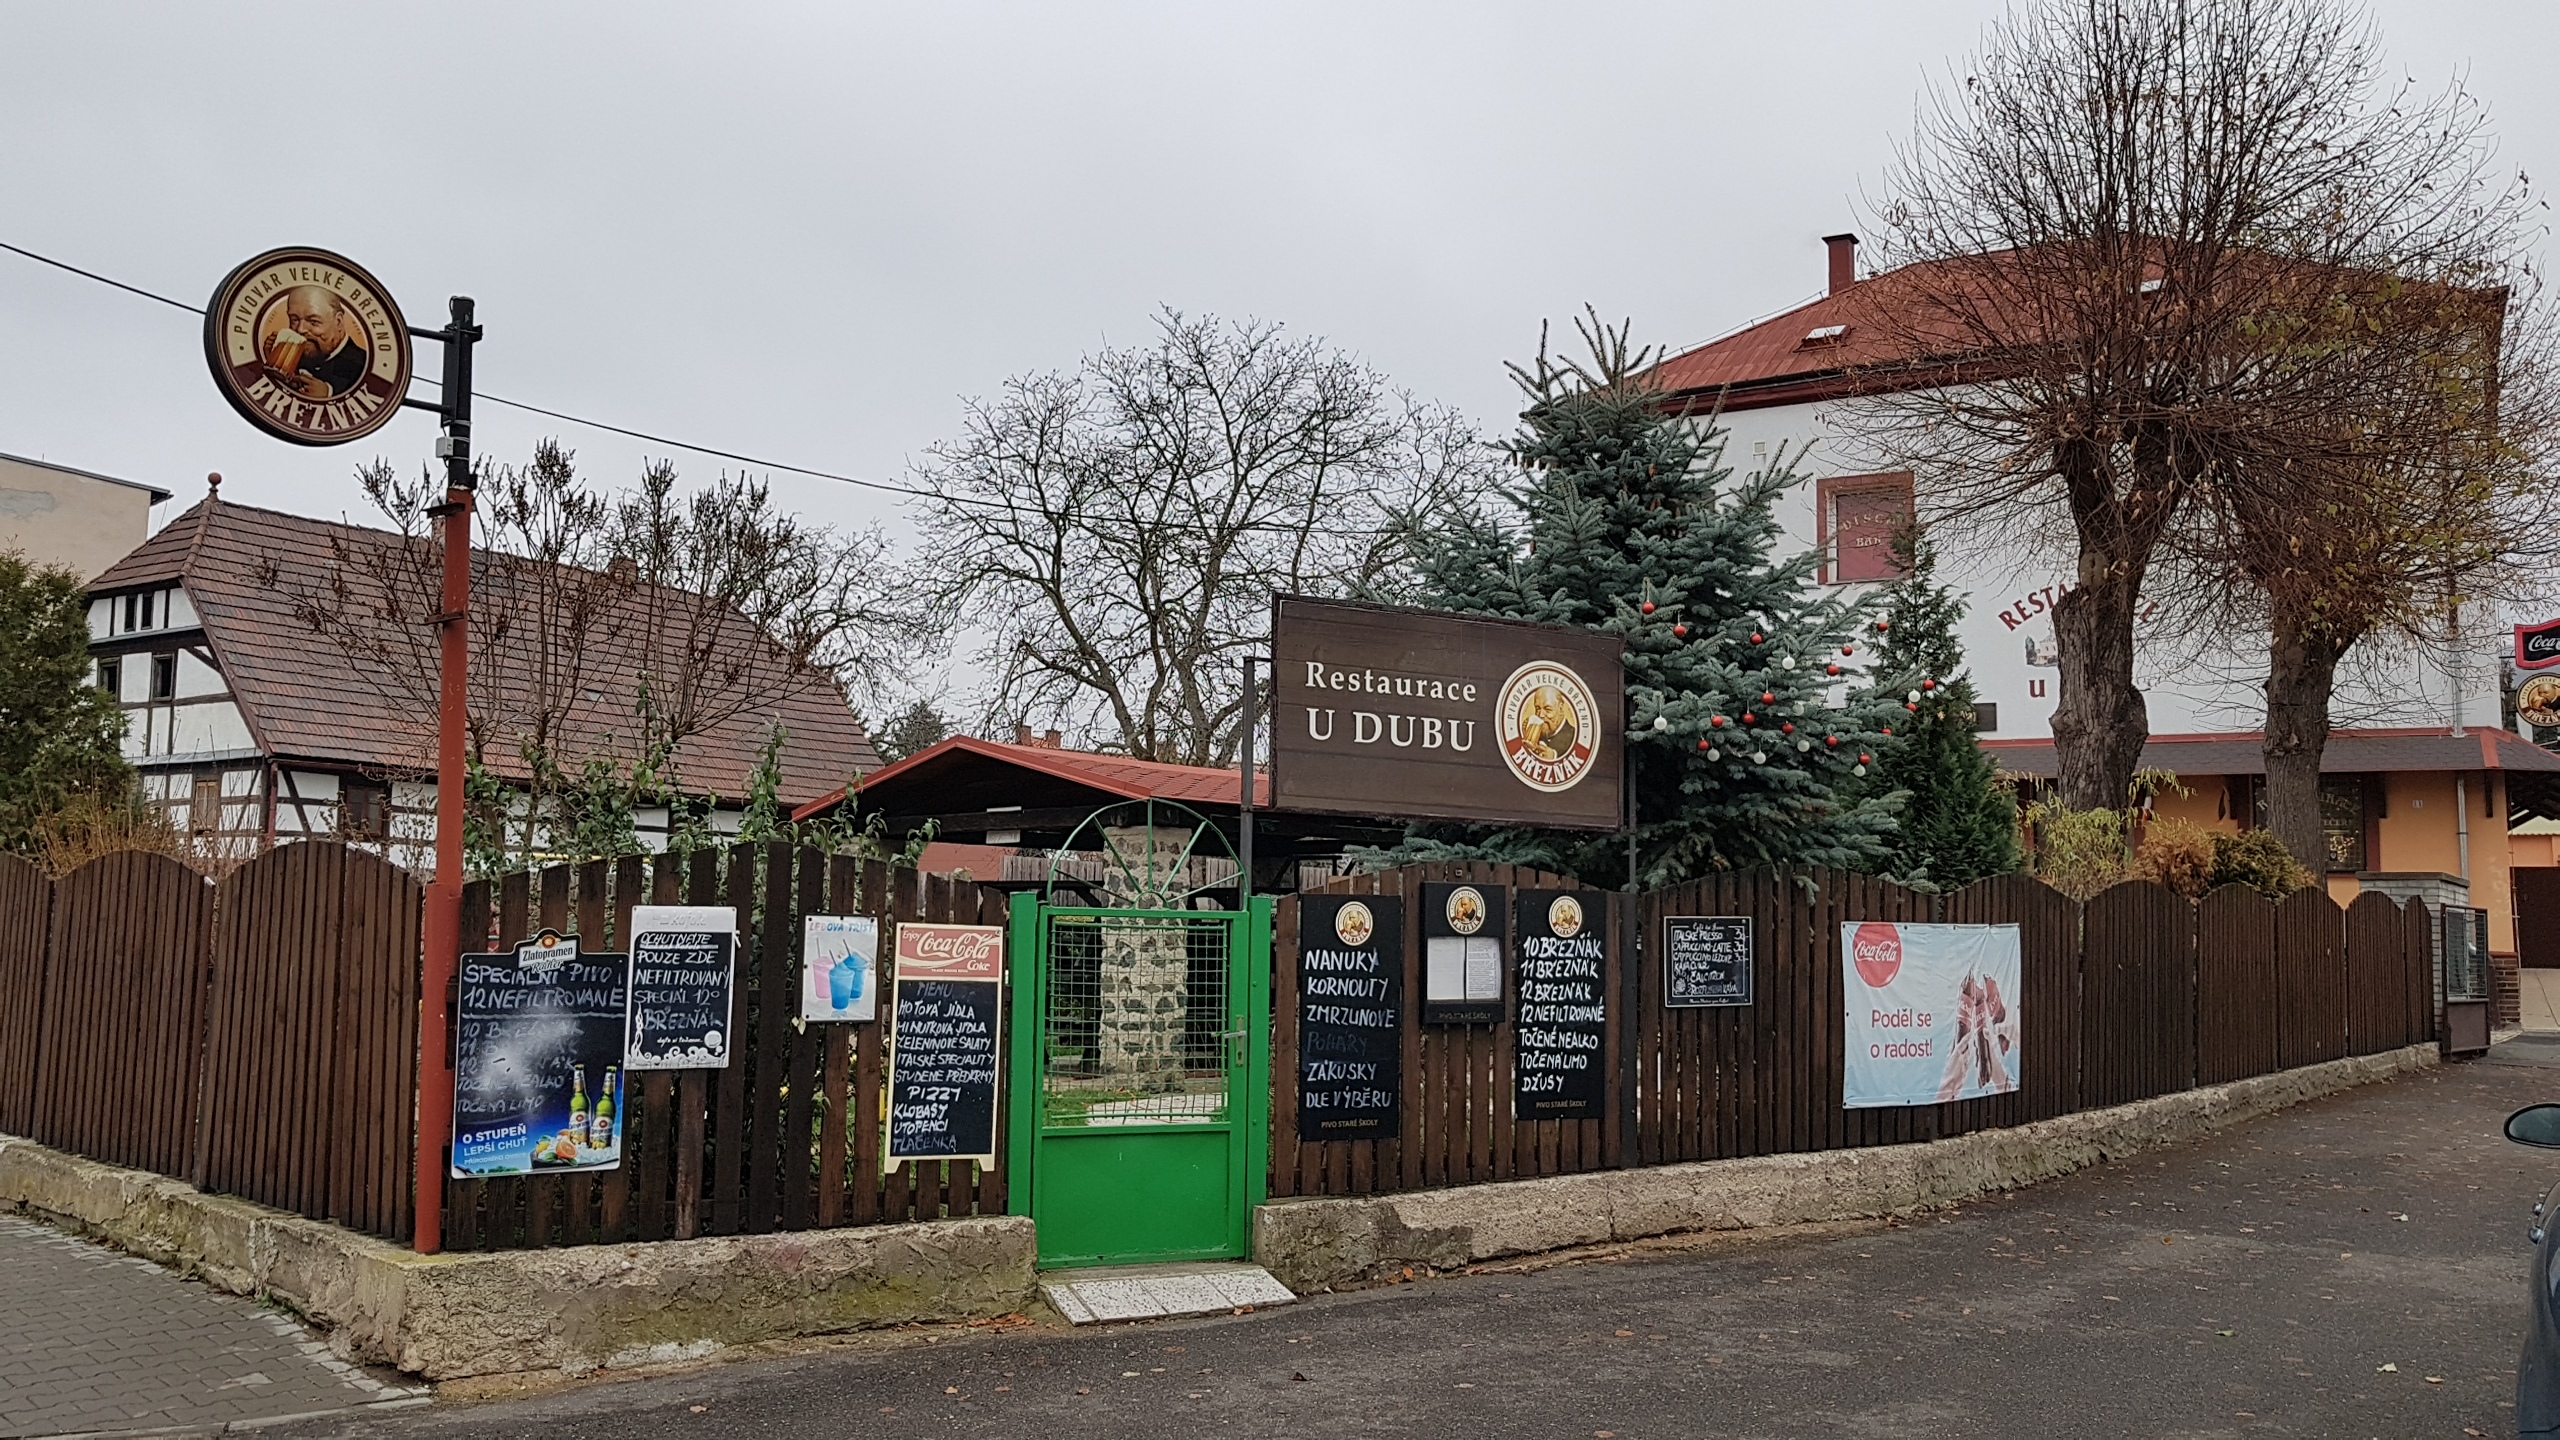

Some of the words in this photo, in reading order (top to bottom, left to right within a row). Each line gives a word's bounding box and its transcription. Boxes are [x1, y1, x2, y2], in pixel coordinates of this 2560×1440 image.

[234, 273, 282, 335] PIVOVAR
[289, 267, 345, 290] VELKÉ
[350, 288, 392, 352] BŘEZNO
[245, 373, 385, 432] BŘEZŇÁK
[1305, 661, 1477, 703] Restaurace
[1507, 680, 1532, 720] PIVOVAR
[1536, 674, 1565, 688] VELKÉ
[1567, 687, 1589, 728] BŘEZNO
[1306, 708, 1335, 741] U
[1353, 711, 1475, 752] DUBU
[1512, 745, 1584, 784] BŘEZŇÁK
[522, 946, 573, 962] Zlatopramen
[902, 930, 921, 942] Enjoy
[916, 931, 992, 960] Coca-Cola
[1523, 935, 1539, 958] 10
[1539, 931, 1603, 959] BŘEZŇÁK
[1854, 940, 1899, 962] Coca-Cola
[636, 951, 680, 965] POUZE
[685, 951, 718, 964] ZDE
[967, 960, 991, 971] Coke
[1520, 959, 1535, 977] 11
[569, 963, 612, 983] PIVO
[634, 965, 729, 989] NEFILTROVANÝ
[1307, 976, 1389, 1002] KORNOUTY
[1520, 979, 1533, 999] 12
[1520, 1002, 1534, 1023] 12
[1871, 1008, 1913, 1028] Poděl
[1917, 1014, 1932, 1028] se
[1519, 1025, 1557, 1048] TOČENÉ
[1558, 1031, 1598, 1050] NEALKO
[1870, 1043, 1880, 1058] o
[1884, 1039, 1933, 1058] radost!
[1306, 1059, 1377, 1082] ZÁKUSKY
[1520, 1050, 1563, 1069] TOČENÁ
[1563, 1054, 1588, 1070] LIMO
[907, 1086, 961, 1102] PIZZY
[1306, 1091, 1329, 1108] DLE
[1333, 1085, 1392, 1109] VÝBĚRU
[462, 1134, 473, 1145] O
[476, 1123, 527, 1142] STUPEŇ
[894, 1118, 949, 1135] UTOPENCI
[1338, 1119, 1358, 1128] STARÉ
[1359, 1118, 1379, 1127] ŠKOLY
[464, 1141, 495, 1156] LEPŠÍ
[498, 1137, 526, 1150] CHUŤ
